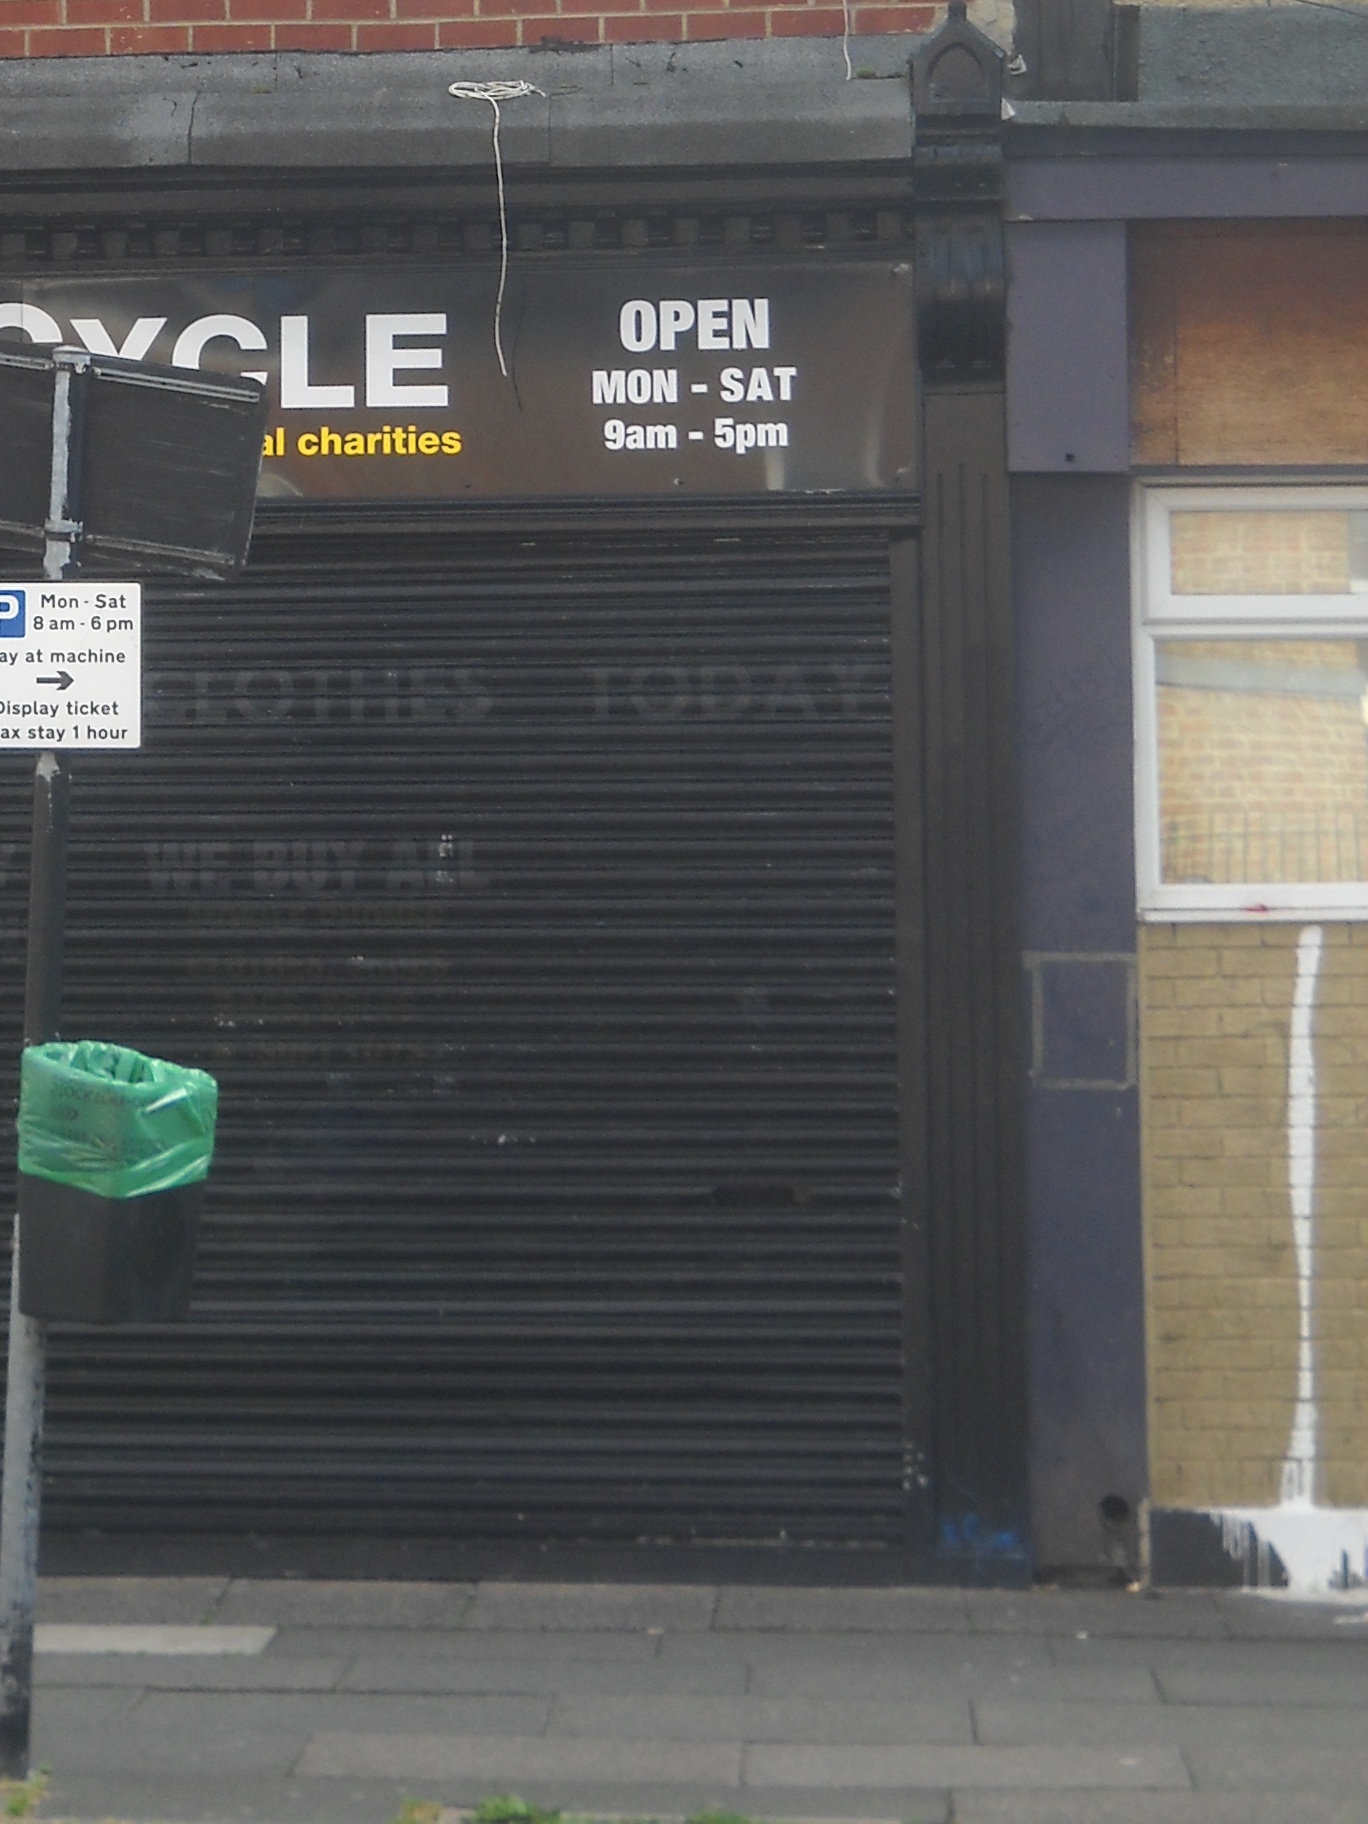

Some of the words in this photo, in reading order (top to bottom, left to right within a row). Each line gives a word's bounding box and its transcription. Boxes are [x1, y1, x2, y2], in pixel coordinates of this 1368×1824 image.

[619, 299, 770, 352] OPEN
[592, 369, 678, 405] MON
[720, 367, 798, 403] SAT
[297, 425, 463, 457] charities
[603, 418, 678, 451] 9am
[714, 417, 790, 455] 5pm
[40, 594, 79, 609] Mon
[94, 594, 127, 609] Sat
[33, 616, 44, 630] 8
[49, 619, 75, 631] am
[90, 616, 102, 630] 6
[106, 619, 134, 633] pm
[25, 649, 44, 663] at
[50, 648, 126, 663] machine
[582, 660, 874, 720] TODAY
[66, 700, 119, 716] ticket
[28, 725, 66, 742] stay
[72, 725, 79, 739] 1
[86, 725, 128, 740] hour
[144, 838, 231, 893] WE
[254, 837, 365, 891] BUY
